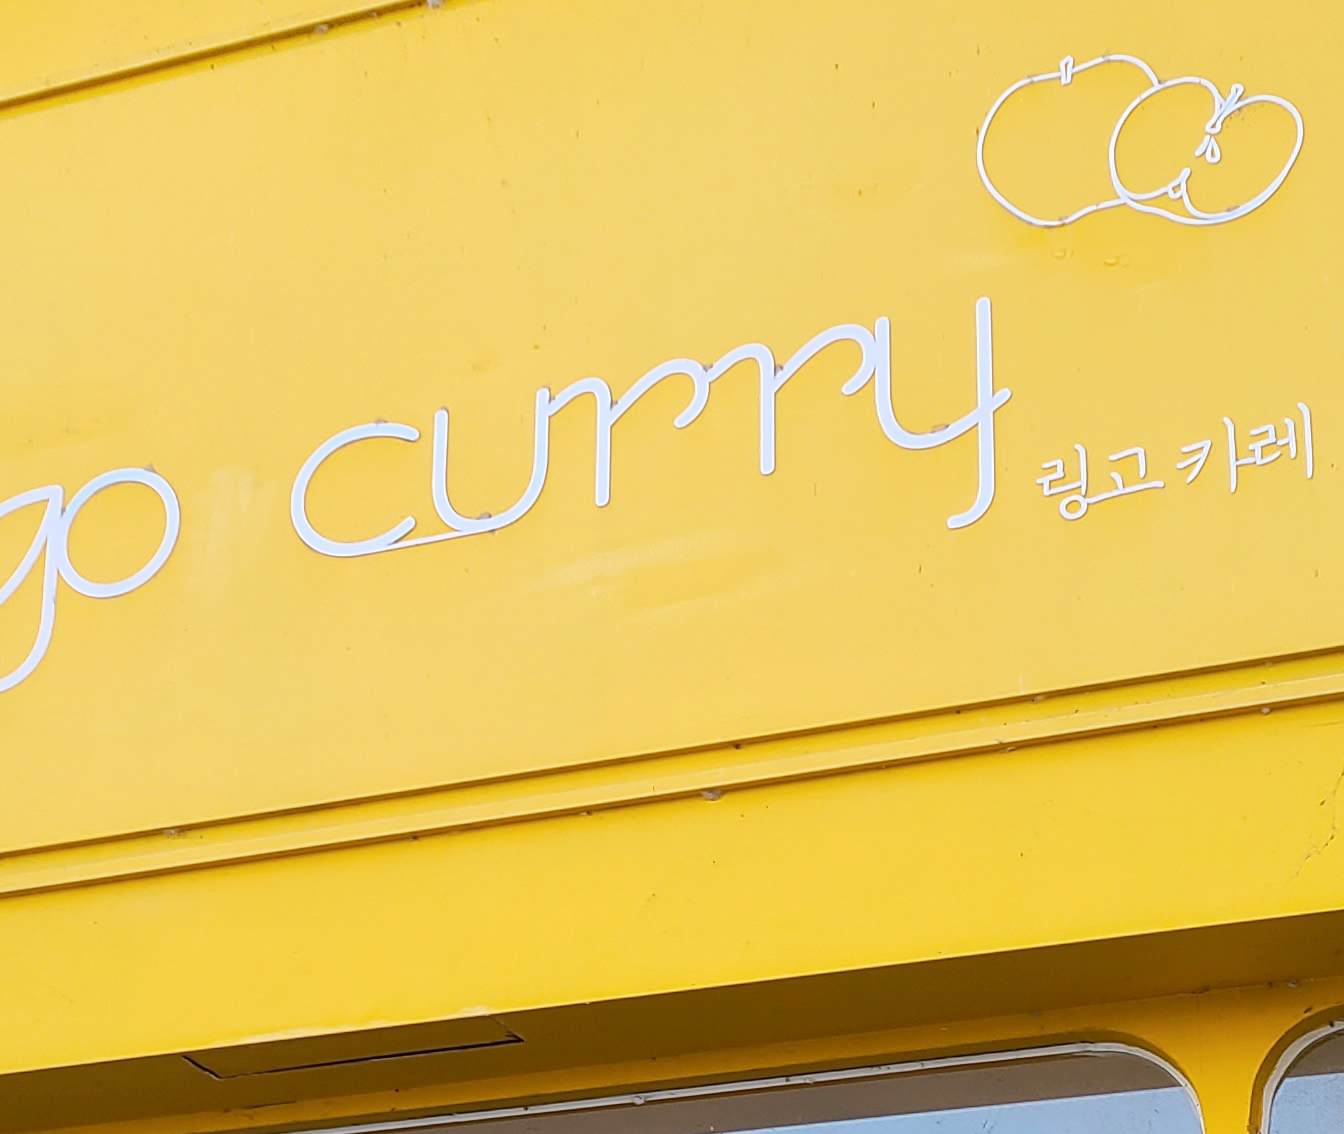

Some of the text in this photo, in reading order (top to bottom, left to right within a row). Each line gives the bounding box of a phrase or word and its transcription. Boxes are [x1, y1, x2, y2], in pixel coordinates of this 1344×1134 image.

[290, 296, 1013, 560] curry
[1036, 402, 1313, 520] 링고 카레
